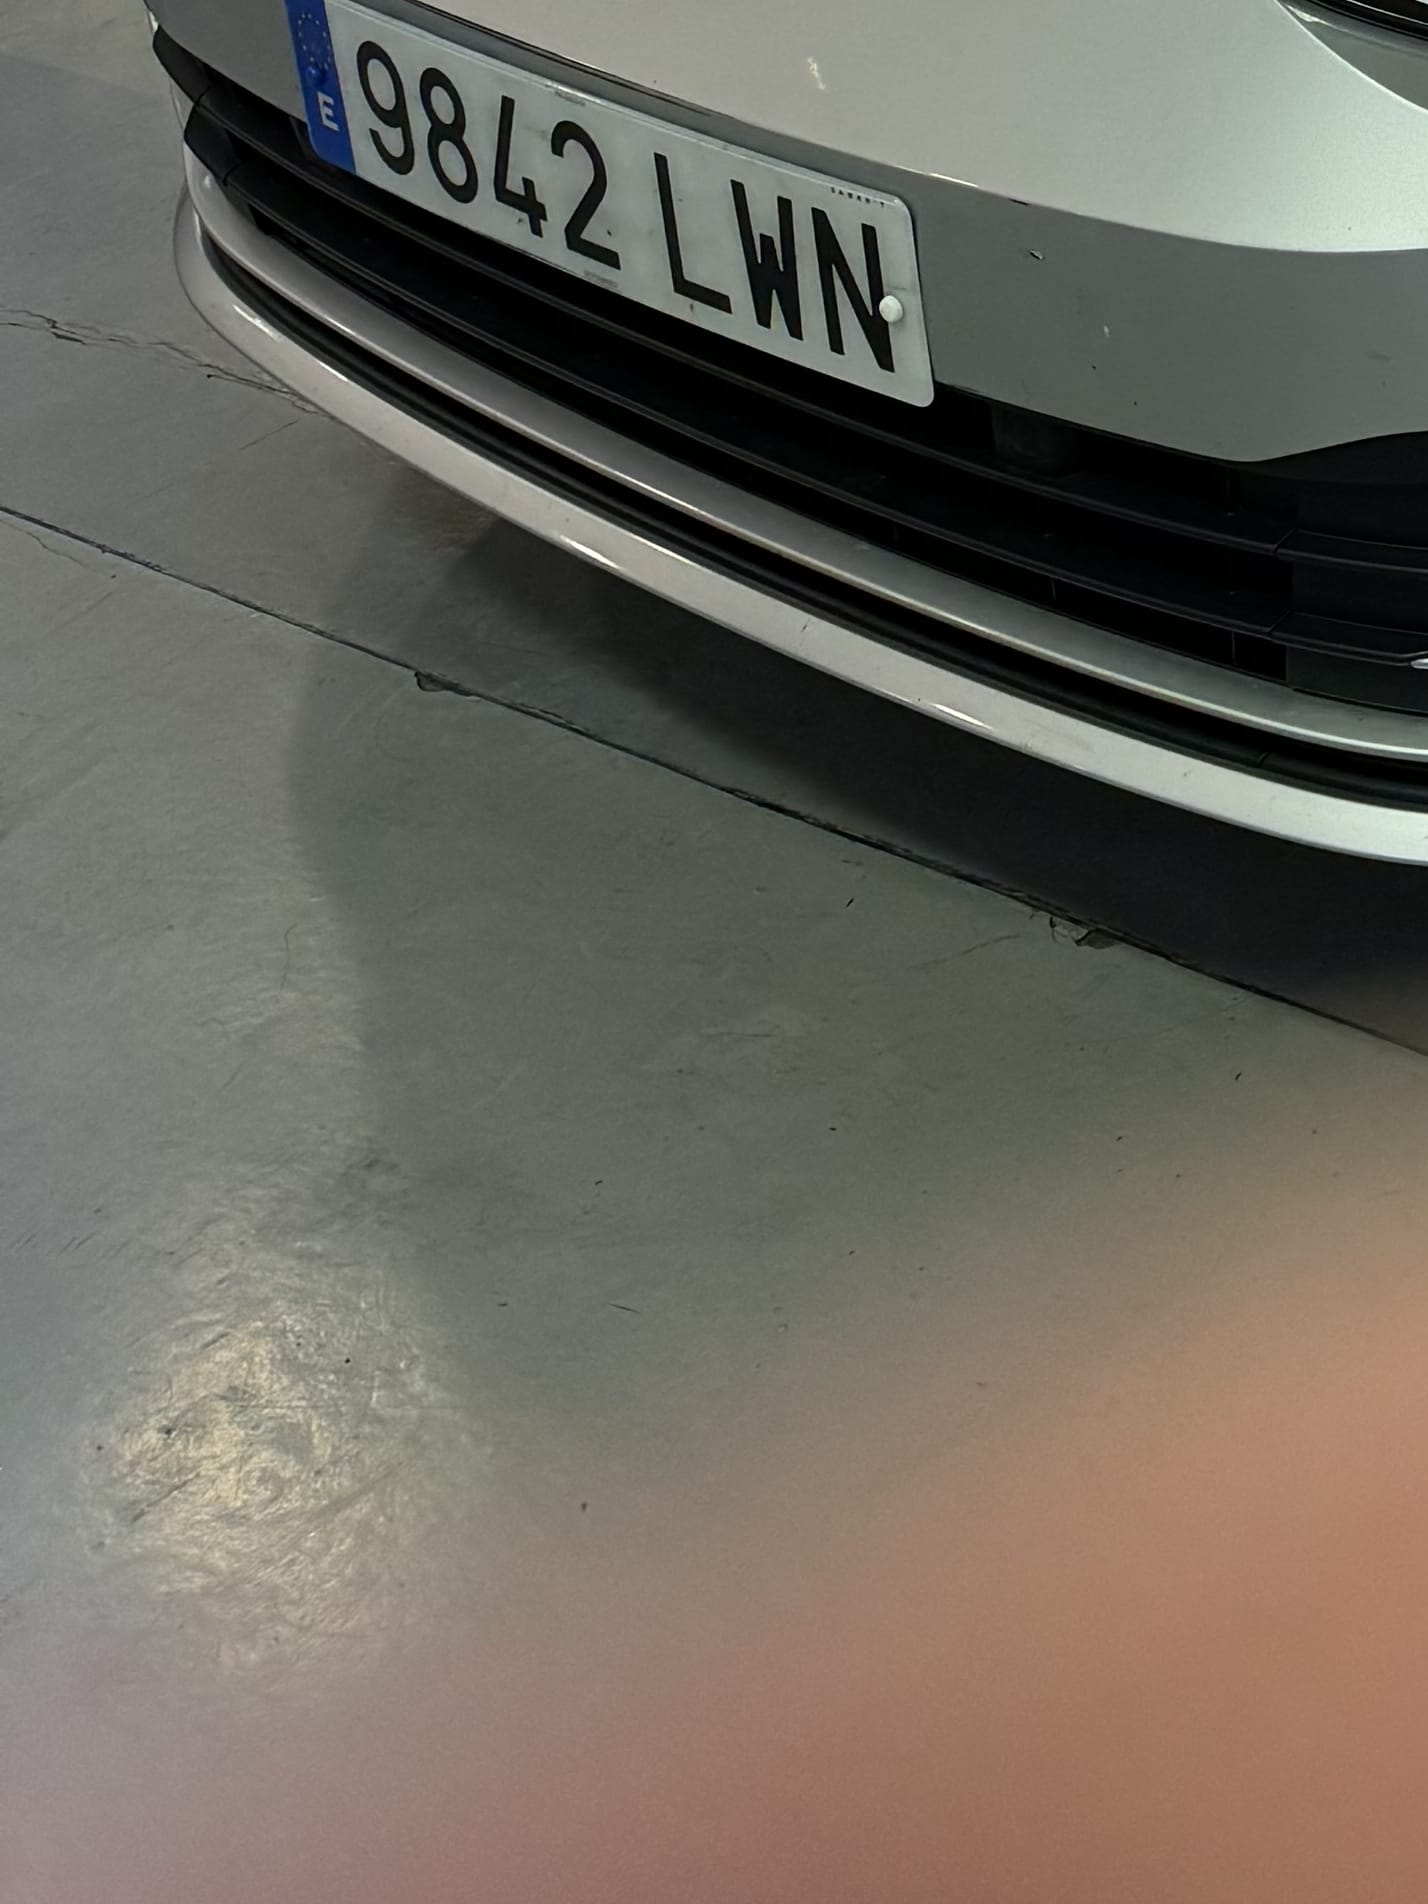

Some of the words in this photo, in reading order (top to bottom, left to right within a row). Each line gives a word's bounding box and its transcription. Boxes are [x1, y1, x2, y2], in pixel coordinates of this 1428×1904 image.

[315, 90, 340, 133] E
[355, 40, 622, 271] 9842
[653, 152, 896, 374] LWN
